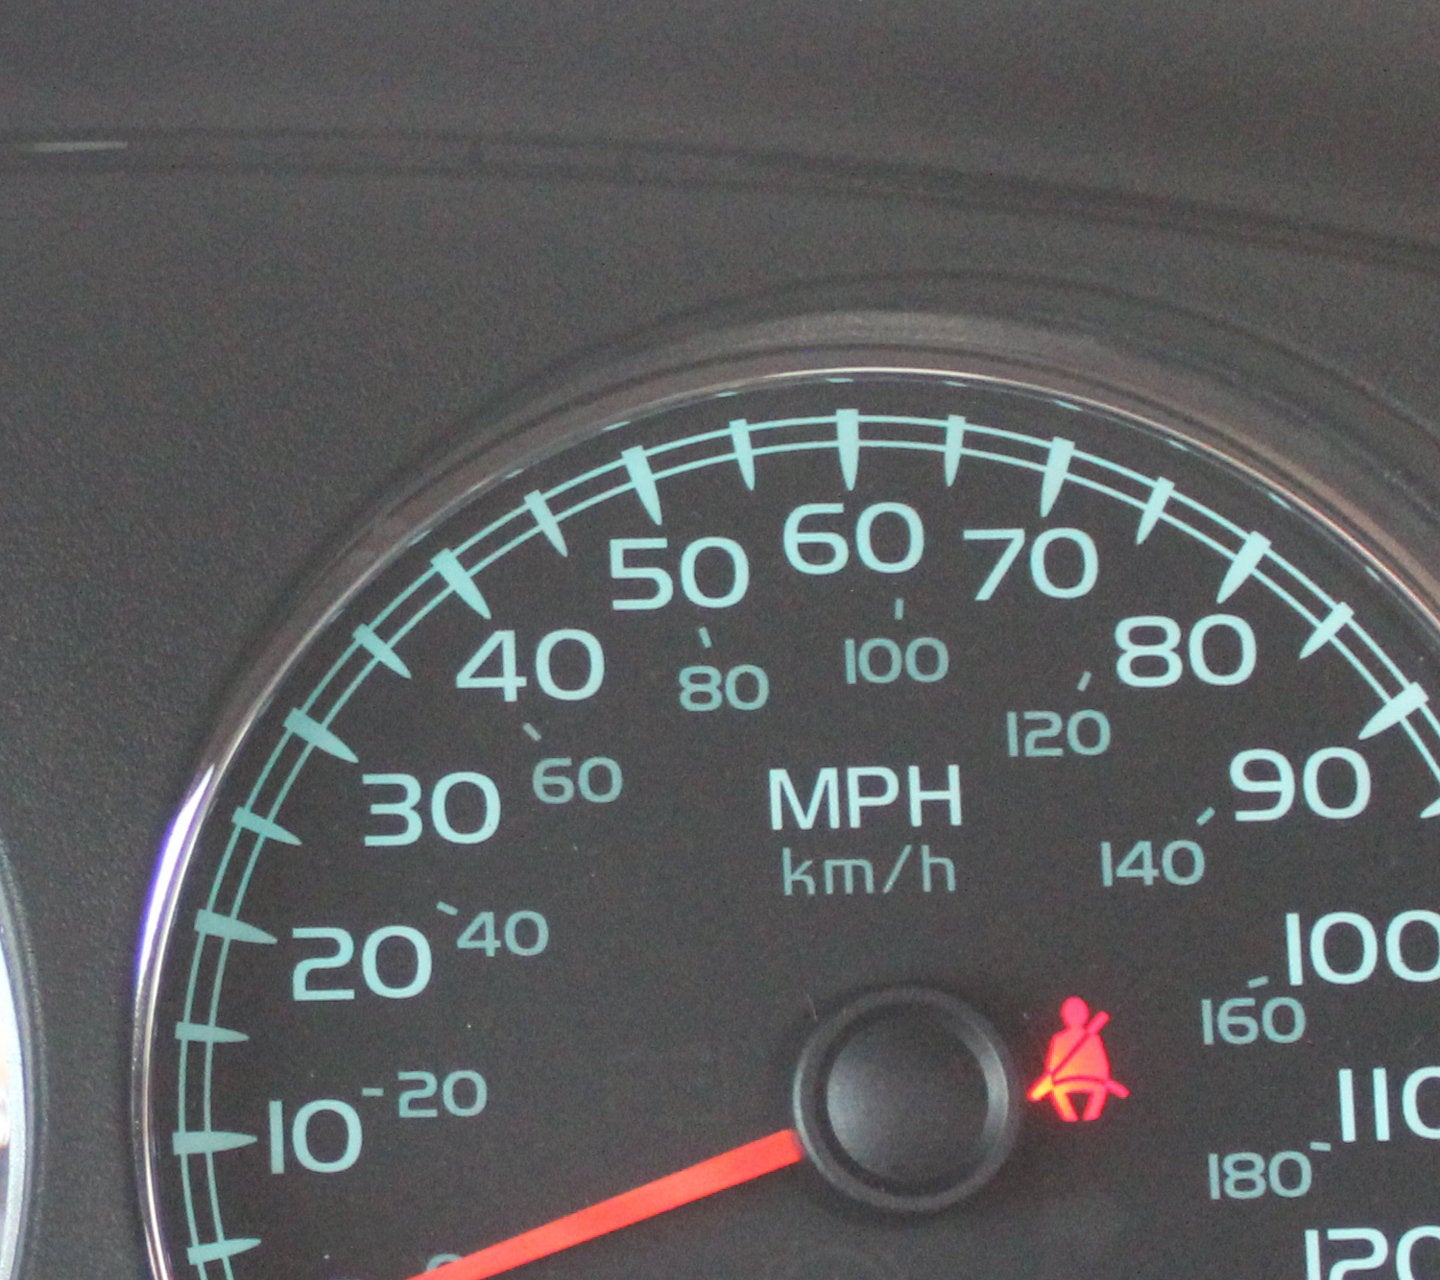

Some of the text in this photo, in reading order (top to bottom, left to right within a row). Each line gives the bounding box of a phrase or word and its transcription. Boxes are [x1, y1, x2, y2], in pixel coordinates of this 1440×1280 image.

[783, 502, 924, 574] 60
[964, 528, 1098, 600] 70
[610, 537, 749, 609] 50
[456, 629, 604, 702] 40
[845, 637, 948, 684] 100
[1115, 614, 1256, 687] 80
[679, 664, 769, 711] 80
[1007, 710, 1110, 756] 120
[533, 757, 622, 803] 60
[769, 765, 961, 830] MPH
[1230, 747, 1370, 822] 90
[363, 772, 500, 846] 30
[783, 845, 955, 895] km/h
[1101, 840, 1205, 886] 140
[454, 909, 548, 957] 40
[293, 926, 432, 1000] 20
[1202, 997, 1305, 1044] 160
[399, 1070, 487, 1117] 20
[270, 1100, 362, 1173] 10
[1209, 1150, 1311, 1199] 180
